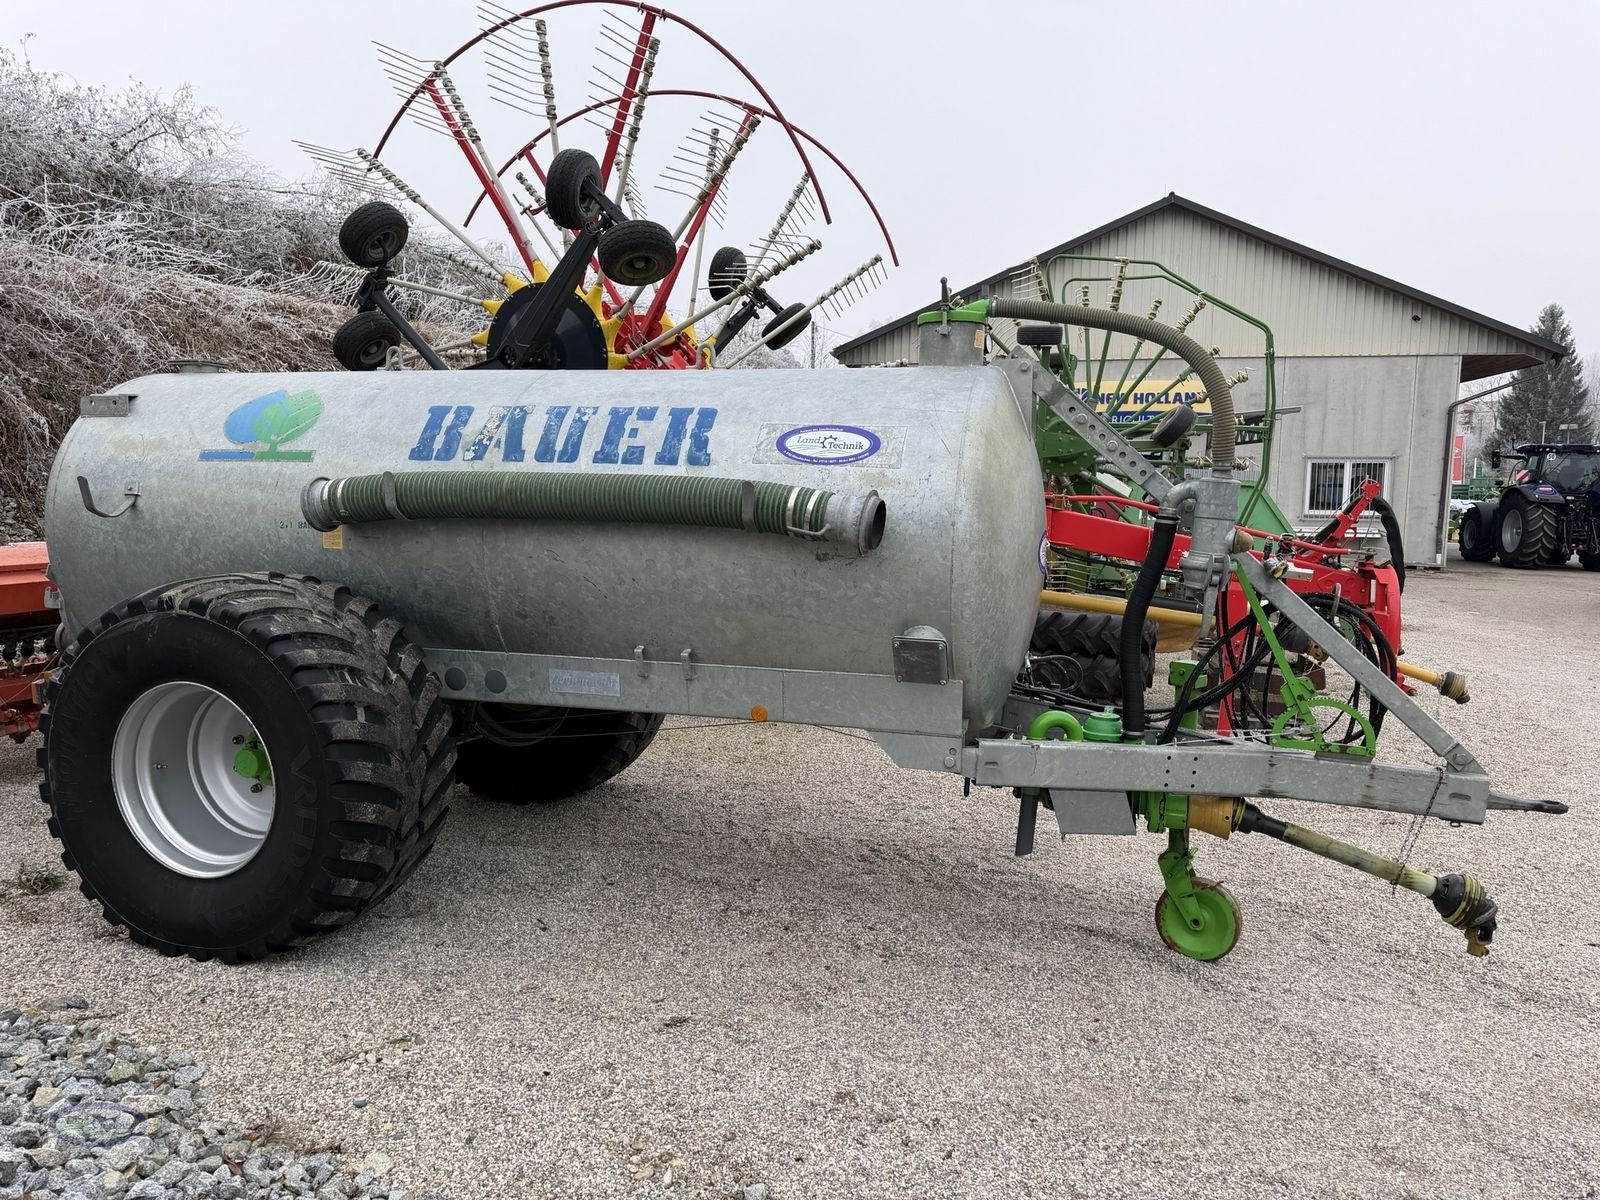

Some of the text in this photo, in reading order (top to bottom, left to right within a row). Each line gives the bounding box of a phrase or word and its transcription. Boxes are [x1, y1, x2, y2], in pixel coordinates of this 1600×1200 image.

[1133, 392, 1206, 404] HOLLAN
[407, 405, 719, 466] BAUER
[797, 436, 821, 444] Land
[828, 442, 864, 450] Technik
